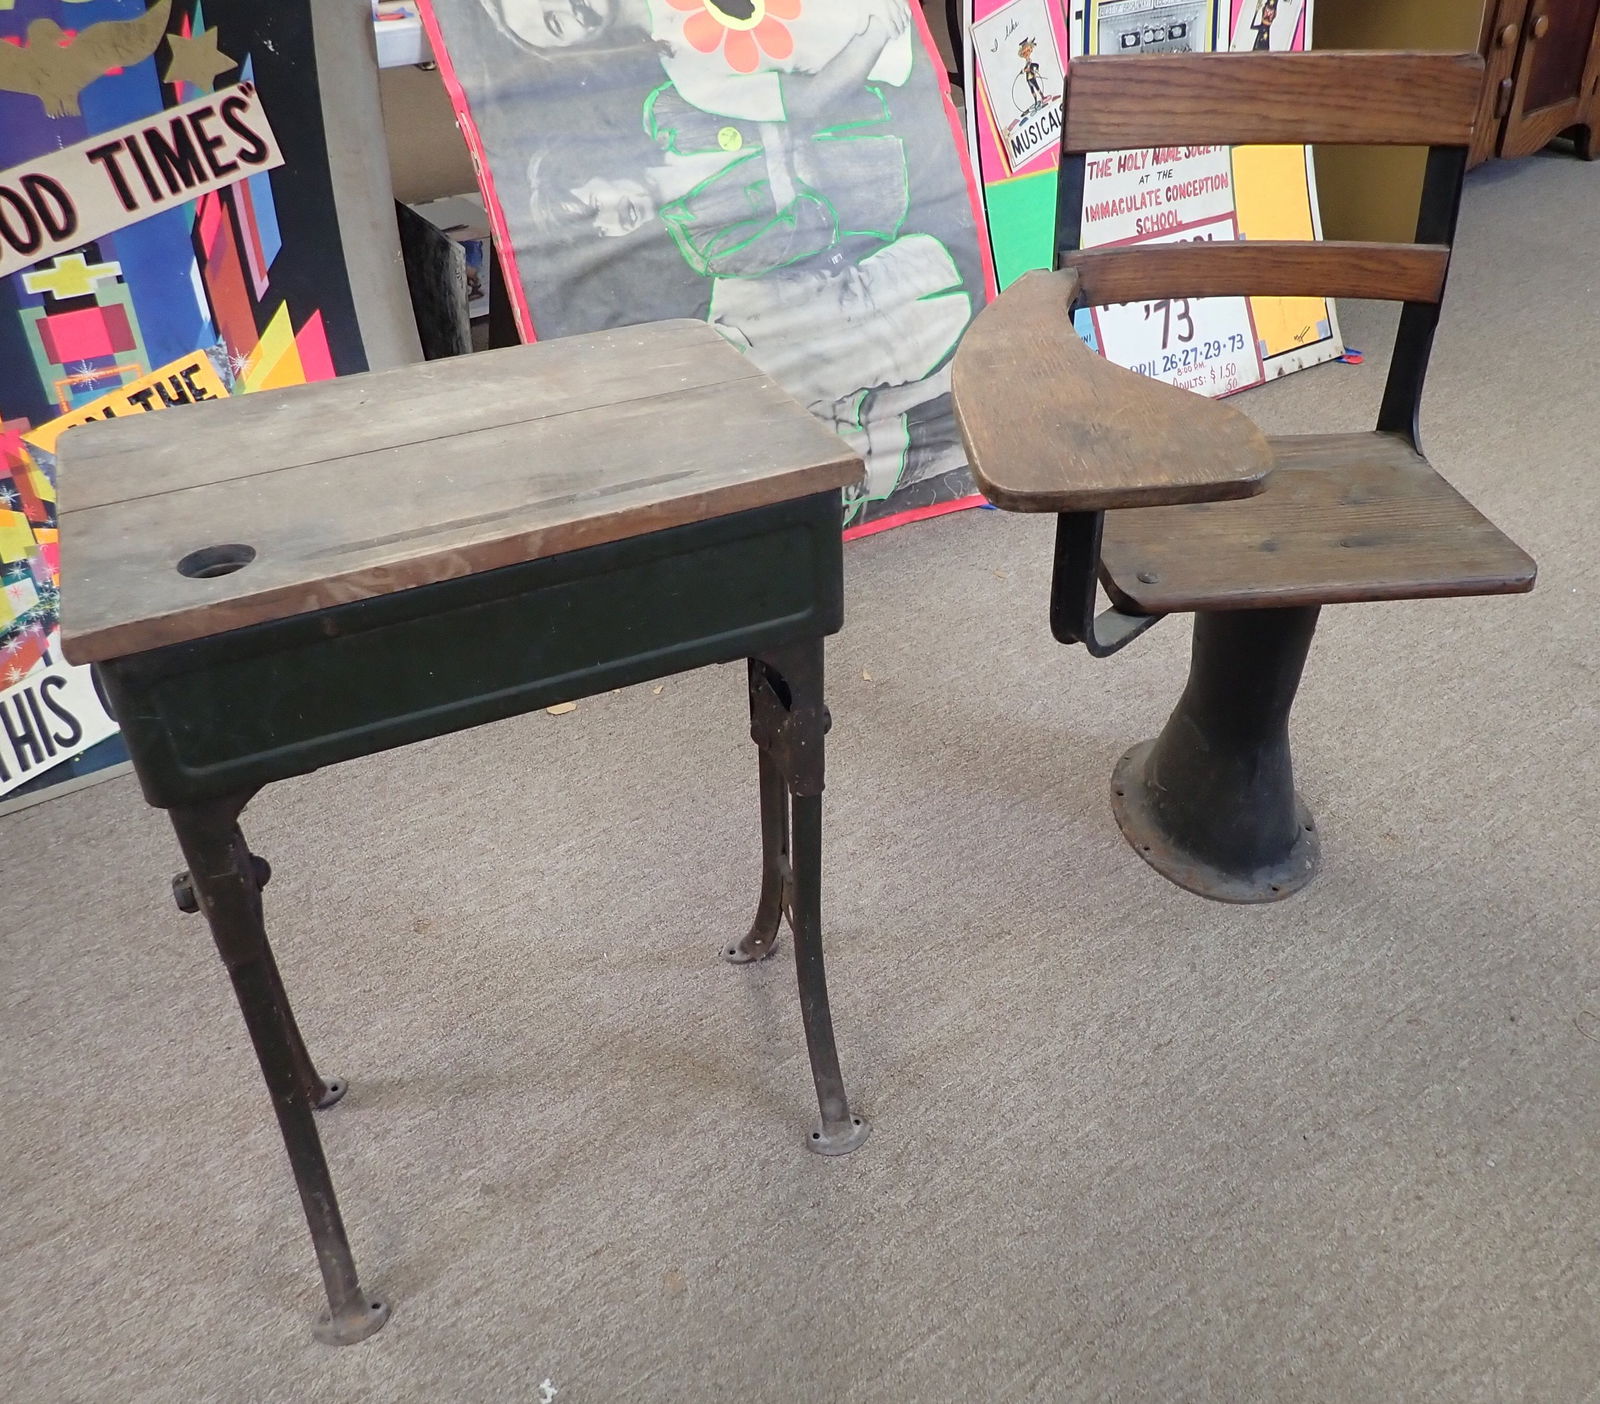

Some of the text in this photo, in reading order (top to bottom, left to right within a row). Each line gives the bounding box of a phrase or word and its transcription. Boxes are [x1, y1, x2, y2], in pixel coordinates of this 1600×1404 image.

[1086, 157, 1113, 181] THE
[1117, 149, 1149, 174] HOLY
[1151, 146, 1183, 167] NAME
[1138, 168, 1174, 186] AT THE
[1085, 172, 1230, 223] IMMACULATE CONCEPTION
[1135, 209, 1183, 236] SCHOOL
[1129, 359, 1160, 378] PRIL
